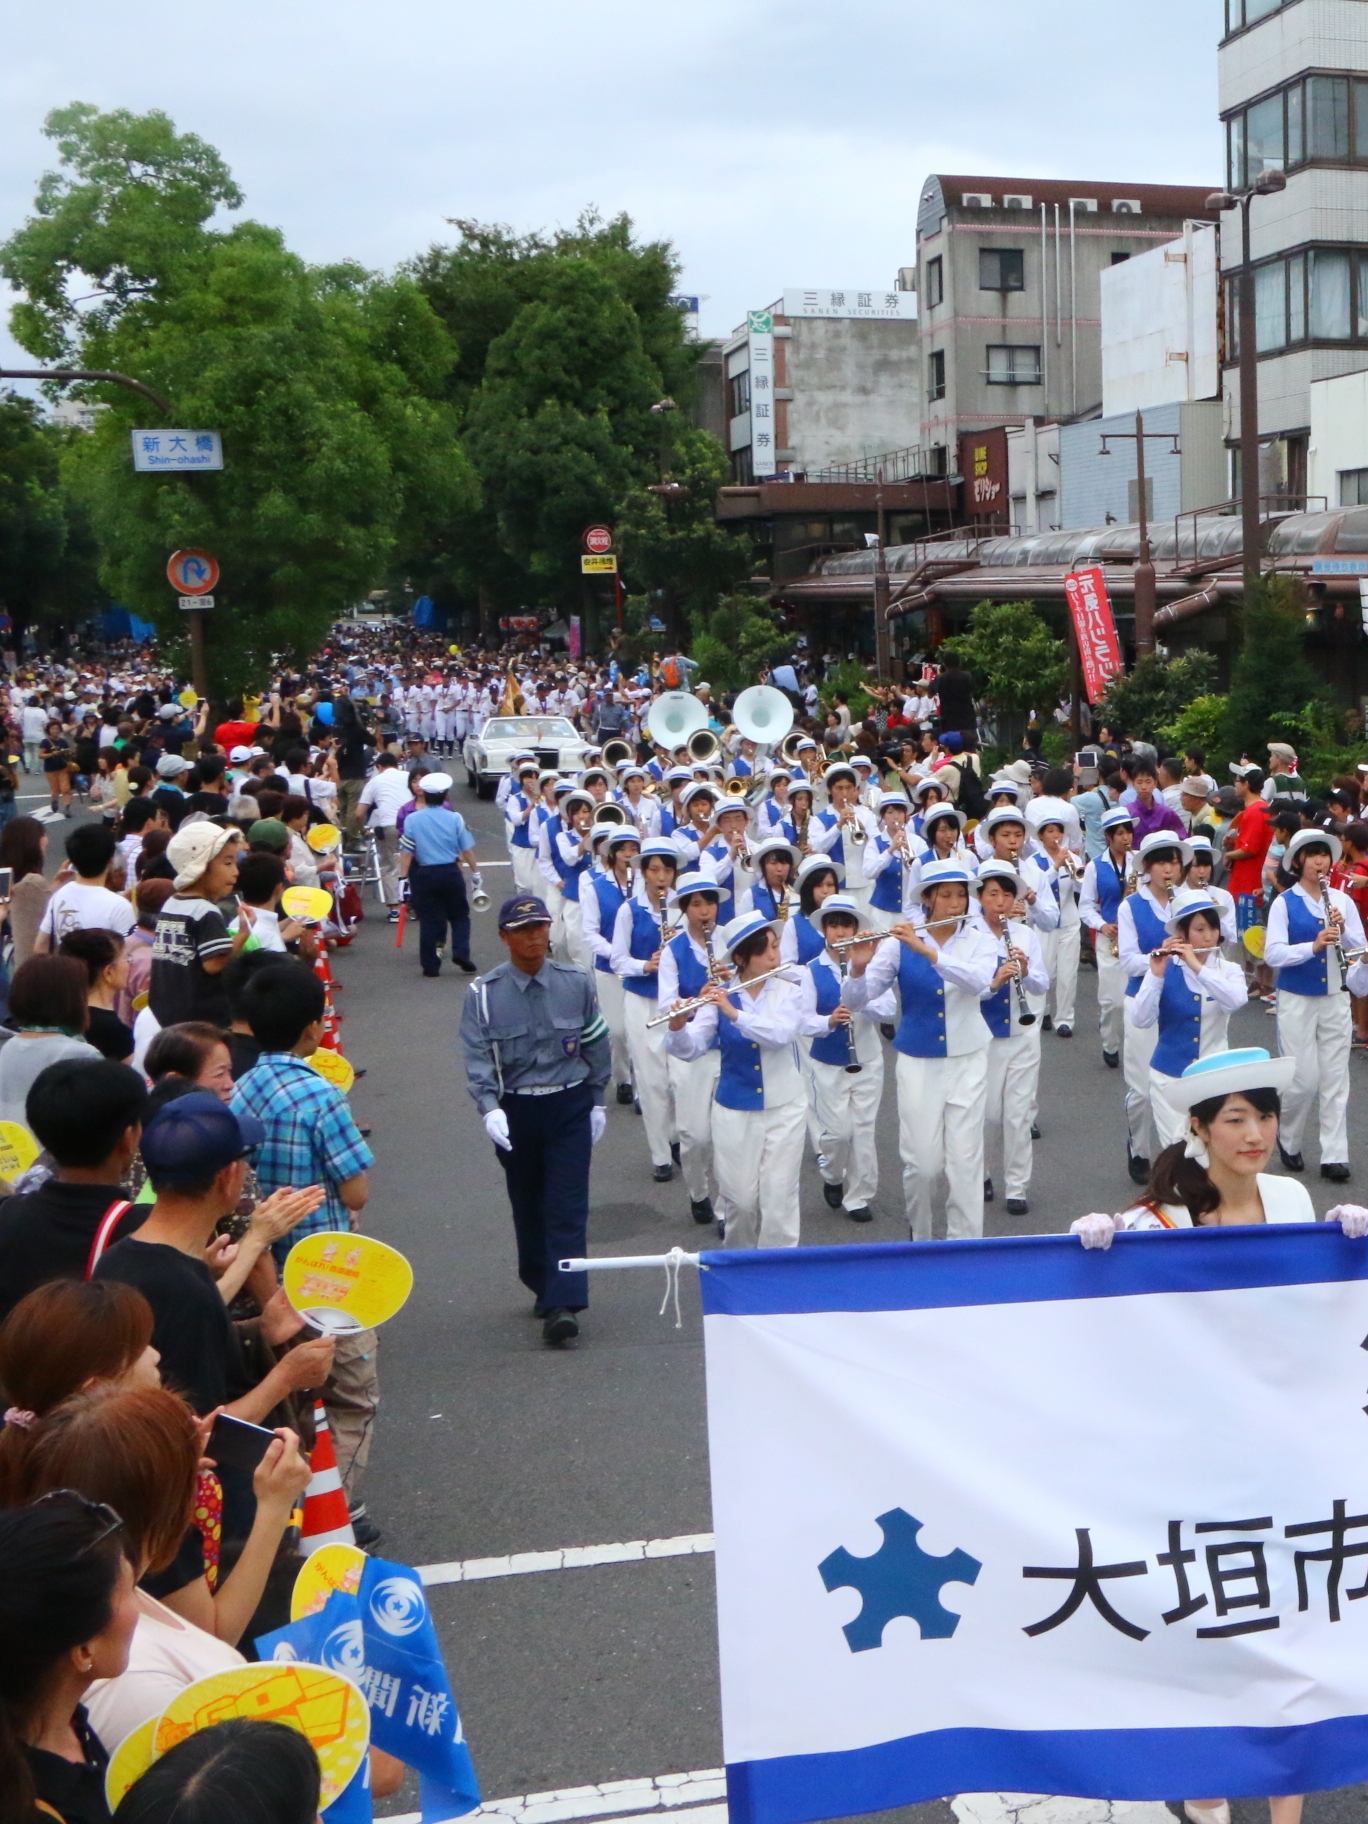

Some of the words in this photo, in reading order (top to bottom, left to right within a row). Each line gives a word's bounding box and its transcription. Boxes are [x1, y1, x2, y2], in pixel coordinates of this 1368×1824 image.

[803, 291, 900, 309] 三縁証券
[803, 307, 839, 315] SANEN
[846, 308, 901, 317] SECURITIES
[753, 347, 771, 448] 三縁証券
[142, 435, 214, 453] 新大橋
[147, 455, 211, 465] Shin-ohashi
